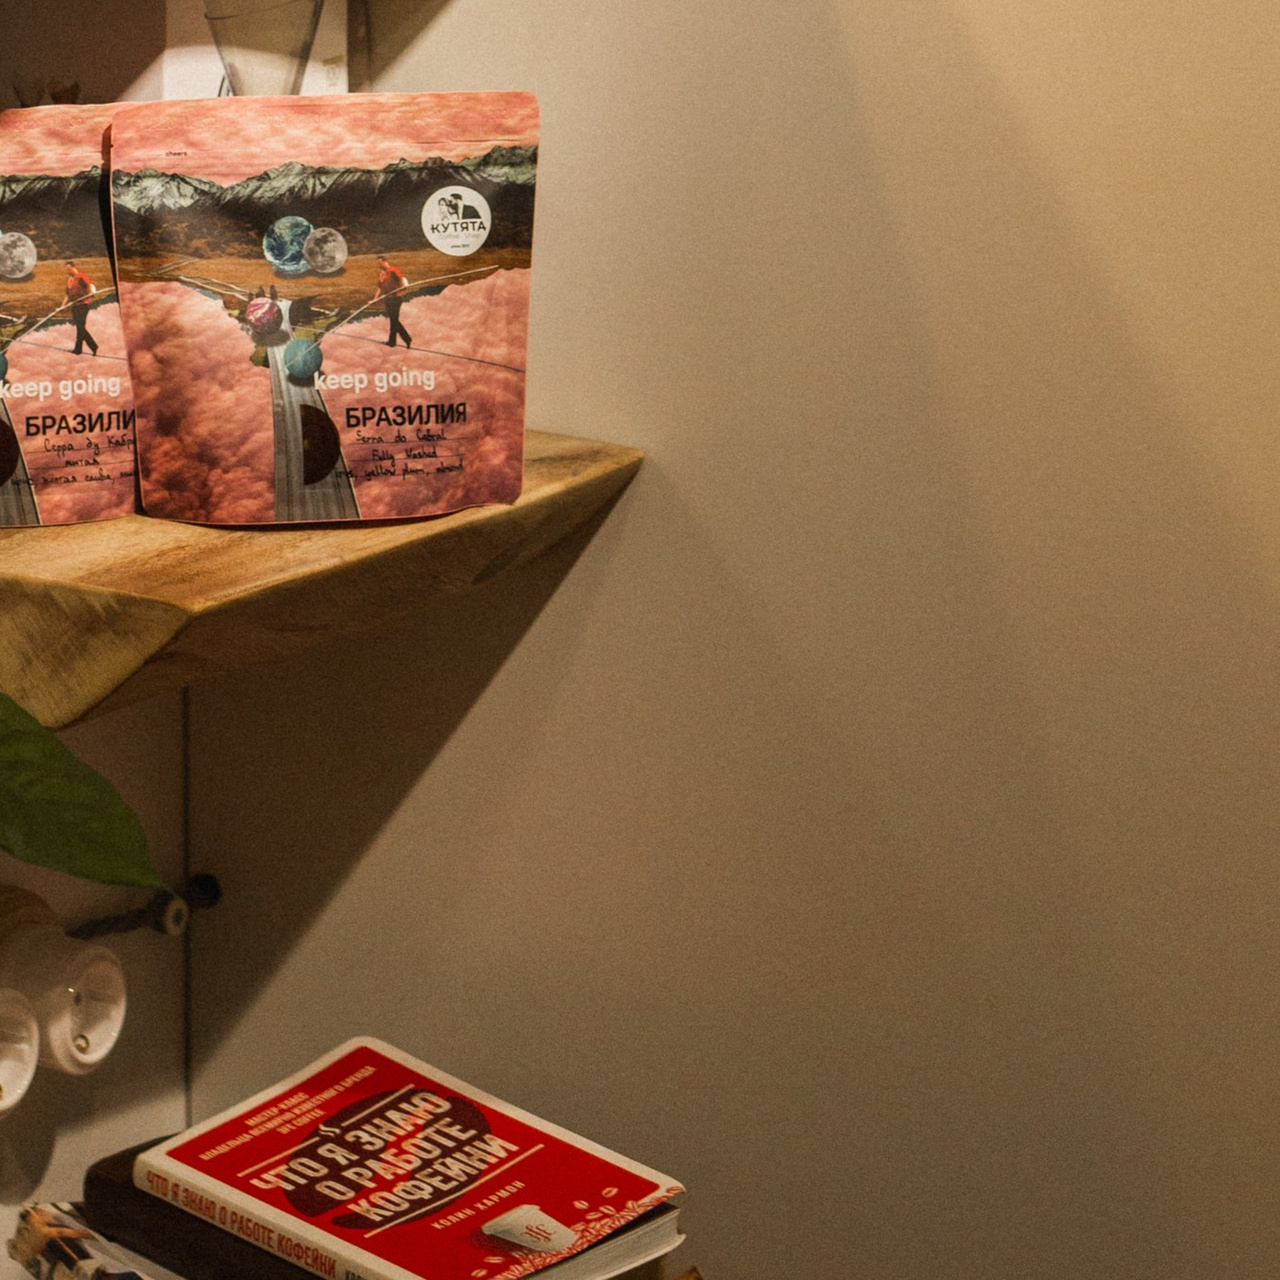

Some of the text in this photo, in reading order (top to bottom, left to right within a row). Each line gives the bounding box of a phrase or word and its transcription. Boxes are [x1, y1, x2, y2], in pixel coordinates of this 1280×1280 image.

[431, 221, 486, 234] КУТЯТА
[58, 373, 121, 401] going
[314, 366, 436, 393] keep going
[25, 408, 136, 437] БРАЗИЛИ
[346, 402, 467, 428] БРАЗИЛИЯ
[199, 1065, 376, 1160] ВЛАДЕЛЬЦА ВСЕМИРНО ИЗВЕСТНОГО БРЕНДА
[245, 1092, 310, 1127] МАСТЕР-КЛАСС
[249, 1092, 452, 1191] ЧТО Я ЗНАЮ
[315, 1117, 478, 1200] О РАБОТЕ
[347, 1133, 521, 1223] КОФЕЙНИ
[147, 1170, 338, 1279] ЧТО Я ЗНАЮ О РАБОТЕ КОФЕЙНИ
[431, 1180, 526, 1230] КОЛИН ХАРМОН
